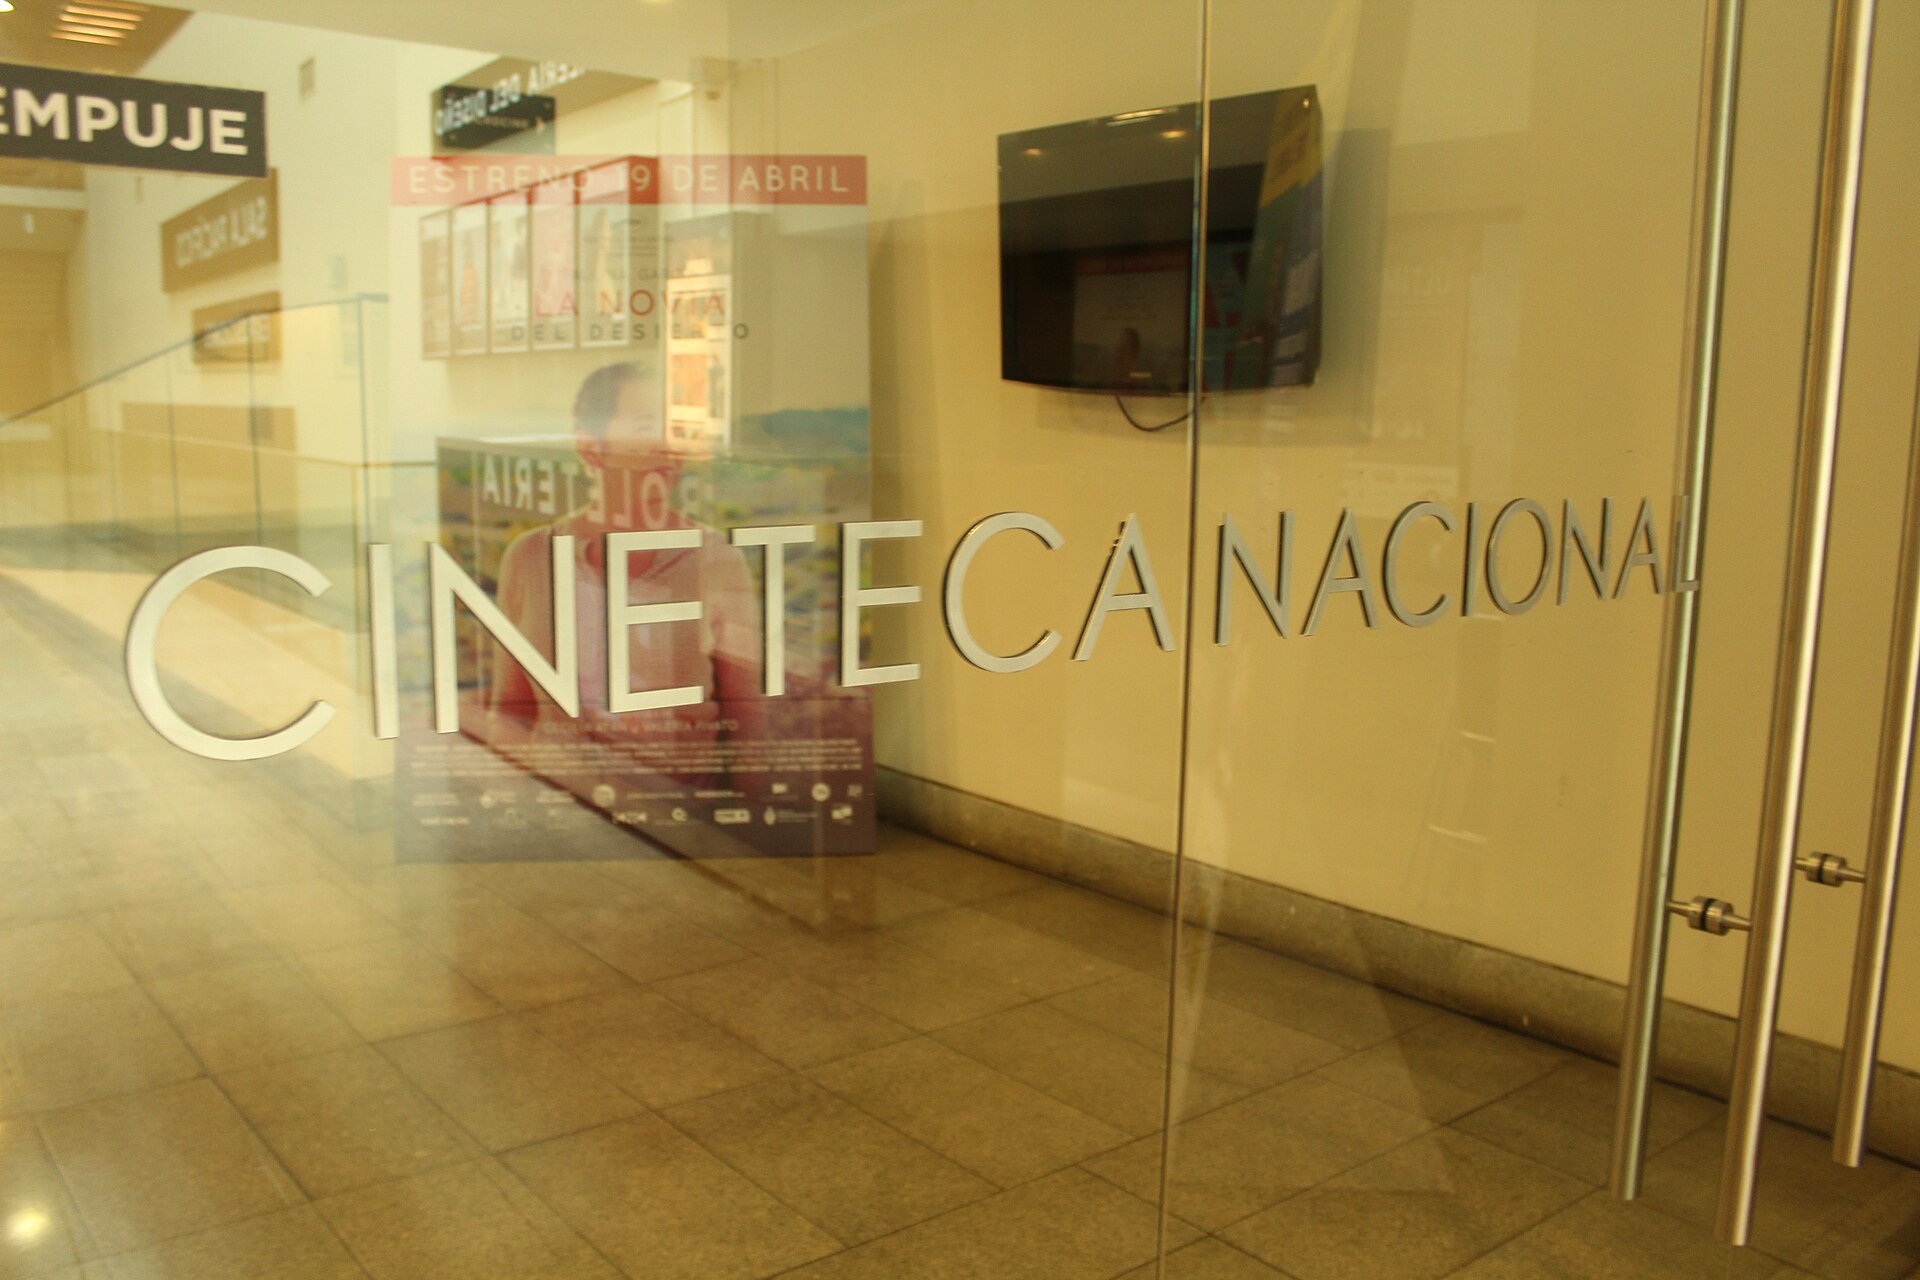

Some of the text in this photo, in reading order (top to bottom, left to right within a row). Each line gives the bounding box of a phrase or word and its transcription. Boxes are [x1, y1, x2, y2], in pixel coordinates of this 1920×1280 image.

[0, 87, 248, 156] MPUJE
[409, 164, 587, 194] ESTRENO
[672, 164, 718, 193] DE
[737, 164, 849, 193] ABRIL
[534, 288, 725, 317] LA NOVIA
[511, 322, 749, 341] DEL DESIERO
[126, 493, 1700, 761] CINETECA NACIONAL
